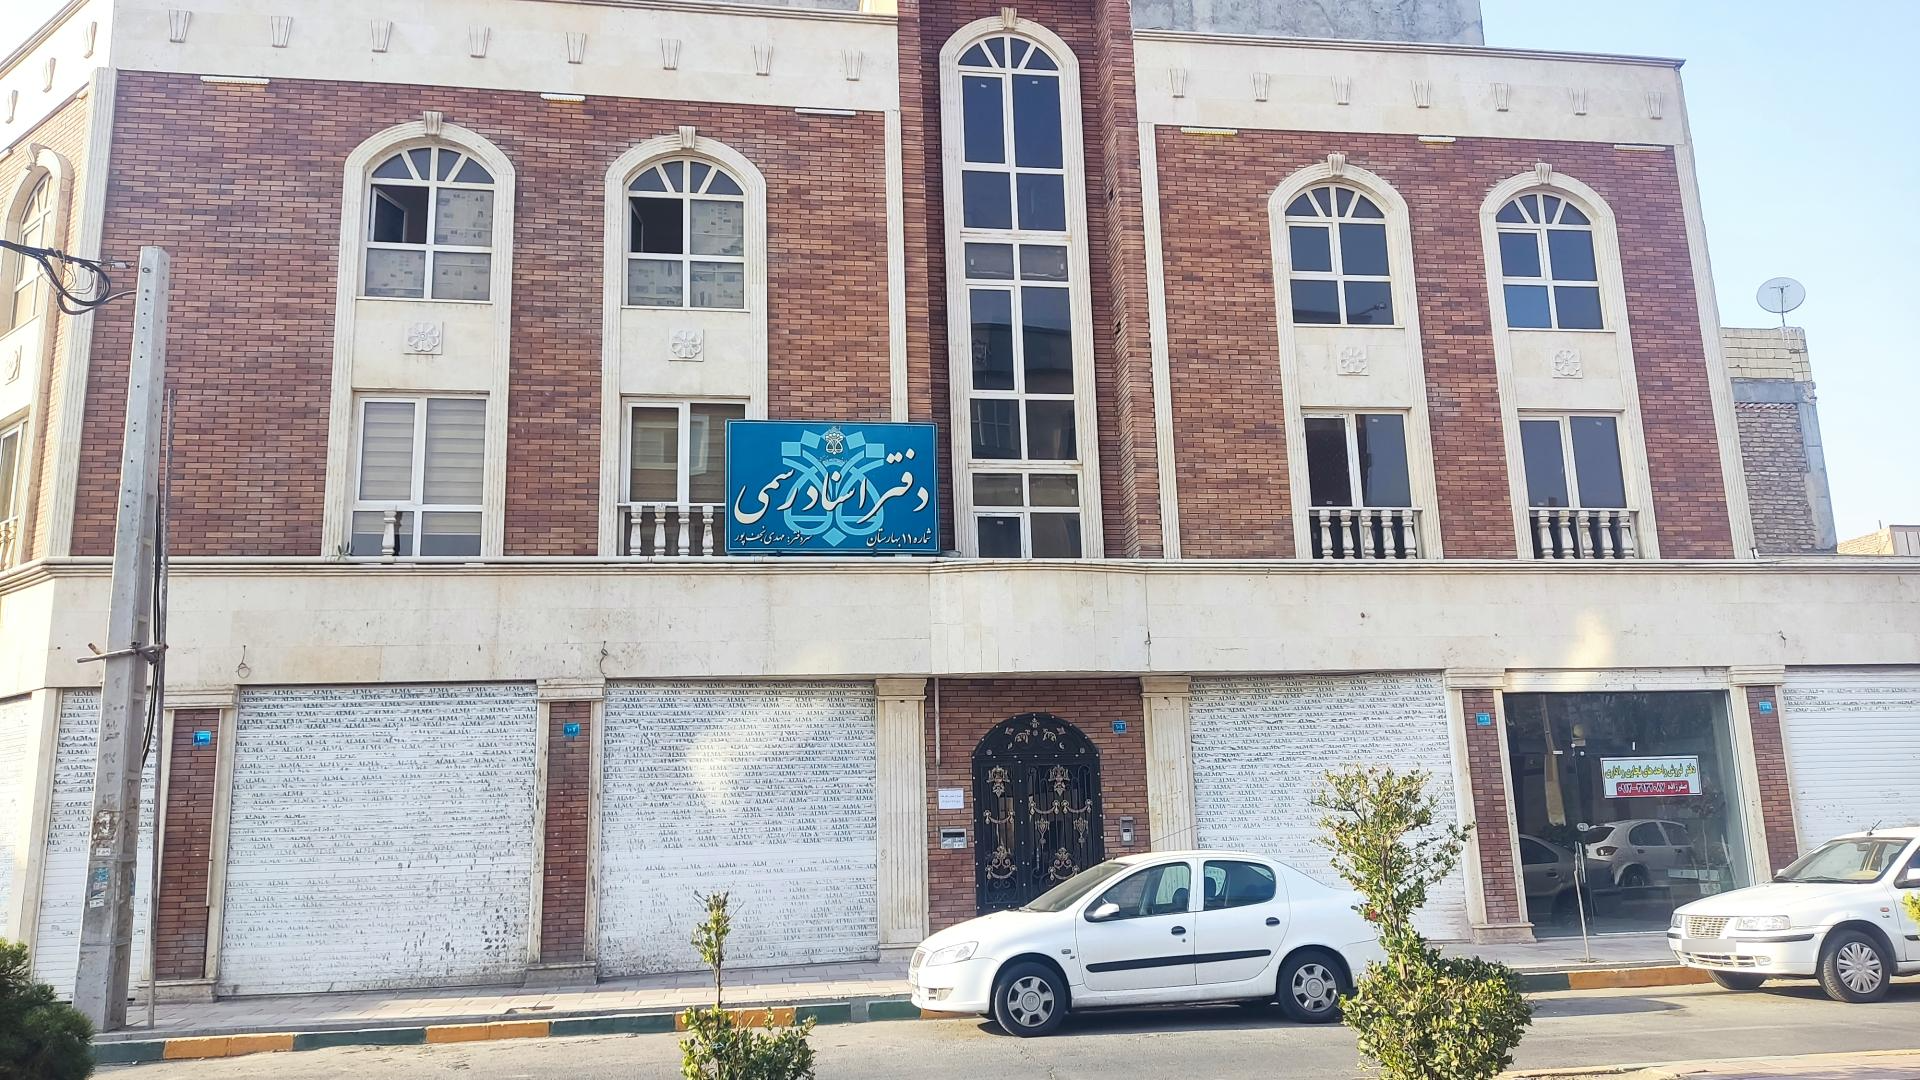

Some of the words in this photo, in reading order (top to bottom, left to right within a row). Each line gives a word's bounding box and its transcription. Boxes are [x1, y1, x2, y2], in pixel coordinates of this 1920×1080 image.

[802, 471, 868, 511] اسناد
[856, 448, 929, 524] دفتر
[734, 468, 799, 524] رسمی
[763, 532, 784, 544] مهدی
[866, 528, 900, 547] بهارستان
[902, 533, 912, 544] ۱۱
[914, 528, 932, 544] شماره
